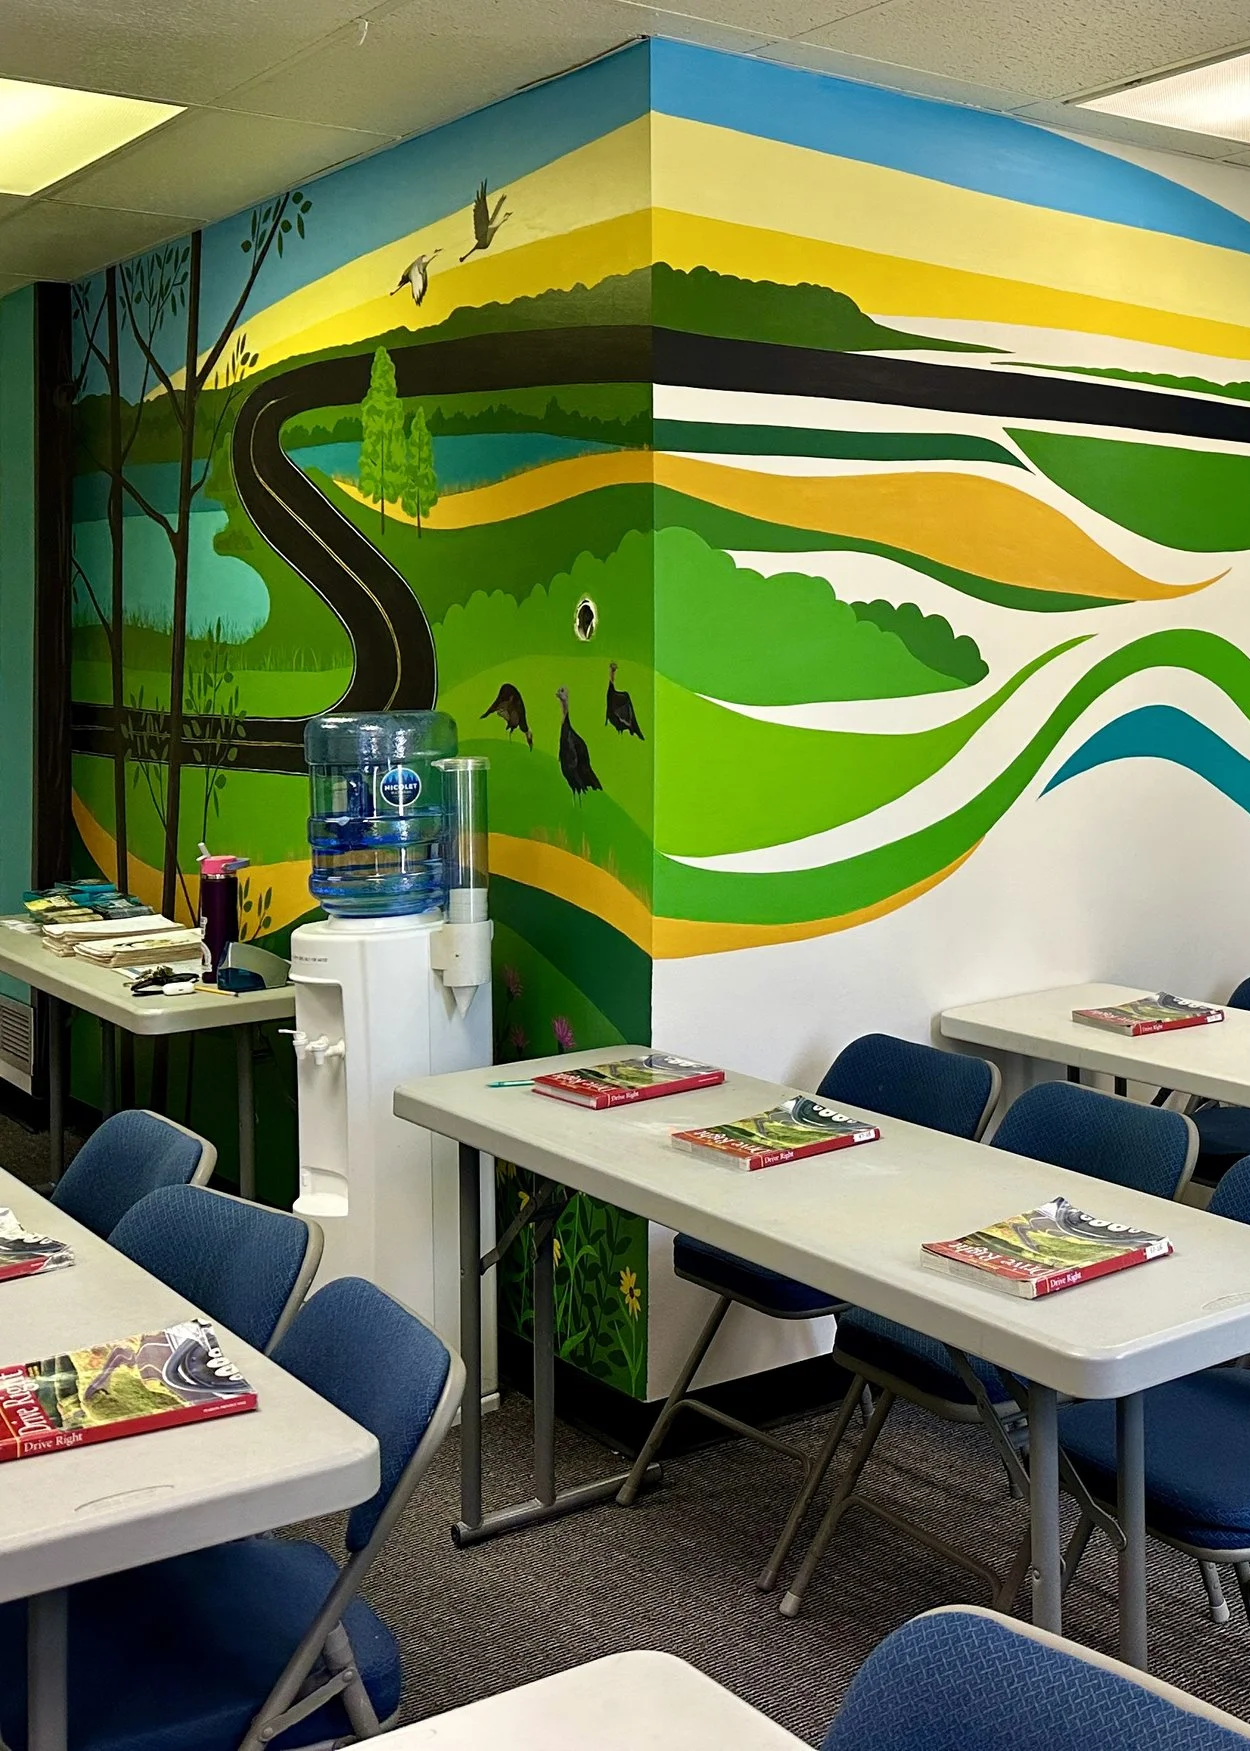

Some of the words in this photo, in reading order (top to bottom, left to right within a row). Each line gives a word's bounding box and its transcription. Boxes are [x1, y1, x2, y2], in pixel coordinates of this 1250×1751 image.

[384, 783, 418, 791] NICOLET
[626, 1090, 640, 1100] Right
[764, 1154, 779, 1164] Drive
[780, 1150, 794, 1161] Right
[1050, 1276, 1066, 1288] Drive
[1066, 1271, 1082, 1283] Right
[0, 1369, 40, 1409] Right
[11, 1406, 52, 1436] Drive
[24, 1439, 53, 1453] Drive
[55, 1432, 83, 1447] Right
